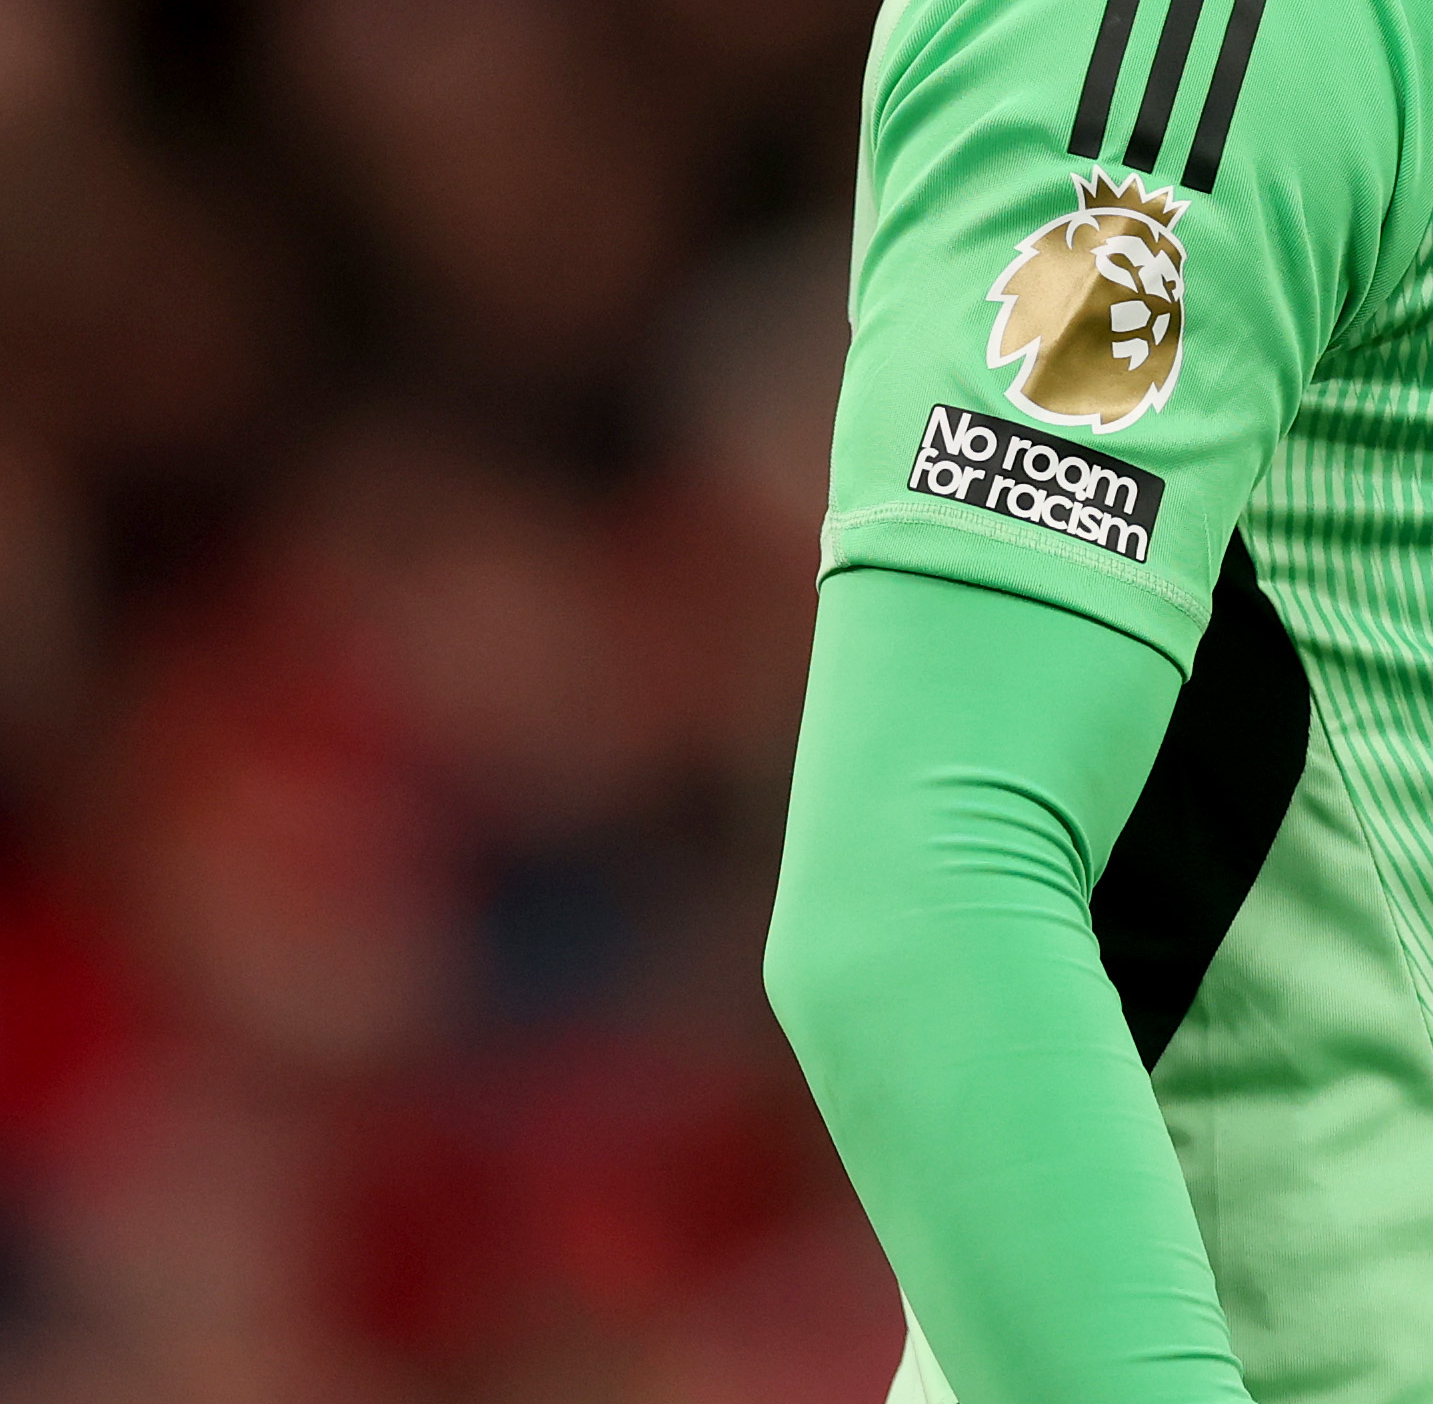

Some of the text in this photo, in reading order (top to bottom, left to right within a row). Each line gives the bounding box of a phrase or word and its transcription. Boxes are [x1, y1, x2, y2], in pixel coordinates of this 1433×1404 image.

[909, 447, 1148, 561] for racism
[921, 406, 1138, 514] No room
